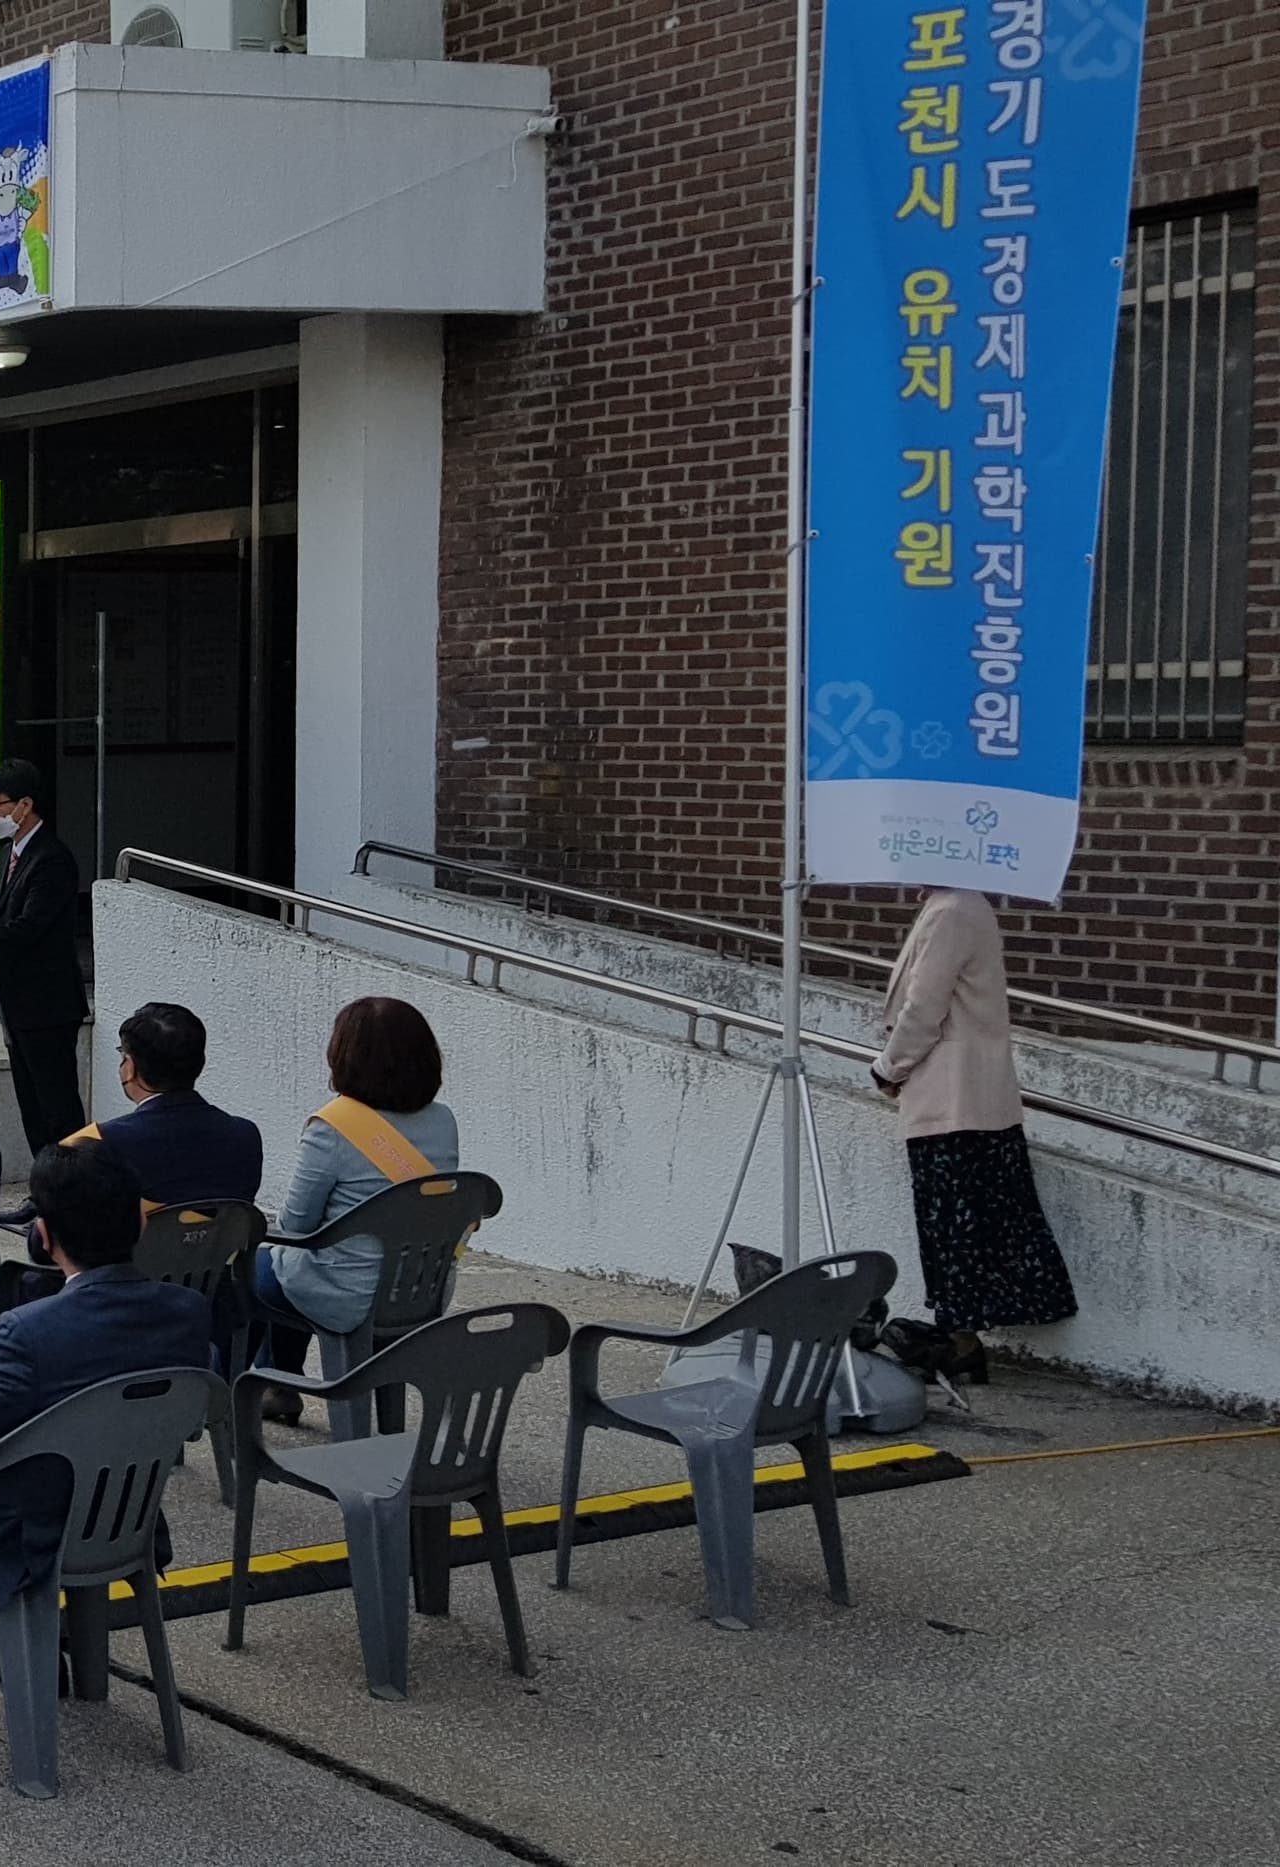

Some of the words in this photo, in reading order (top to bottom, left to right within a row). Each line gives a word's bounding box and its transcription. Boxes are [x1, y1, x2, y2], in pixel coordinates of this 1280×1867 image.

[897, 8, 967, 231] 포천시
[898, 268, 958, 411] 유치
[967, 0, 1045, 758] 경기도경제과학진흥원
[895, 448, 955, 589] 기원
